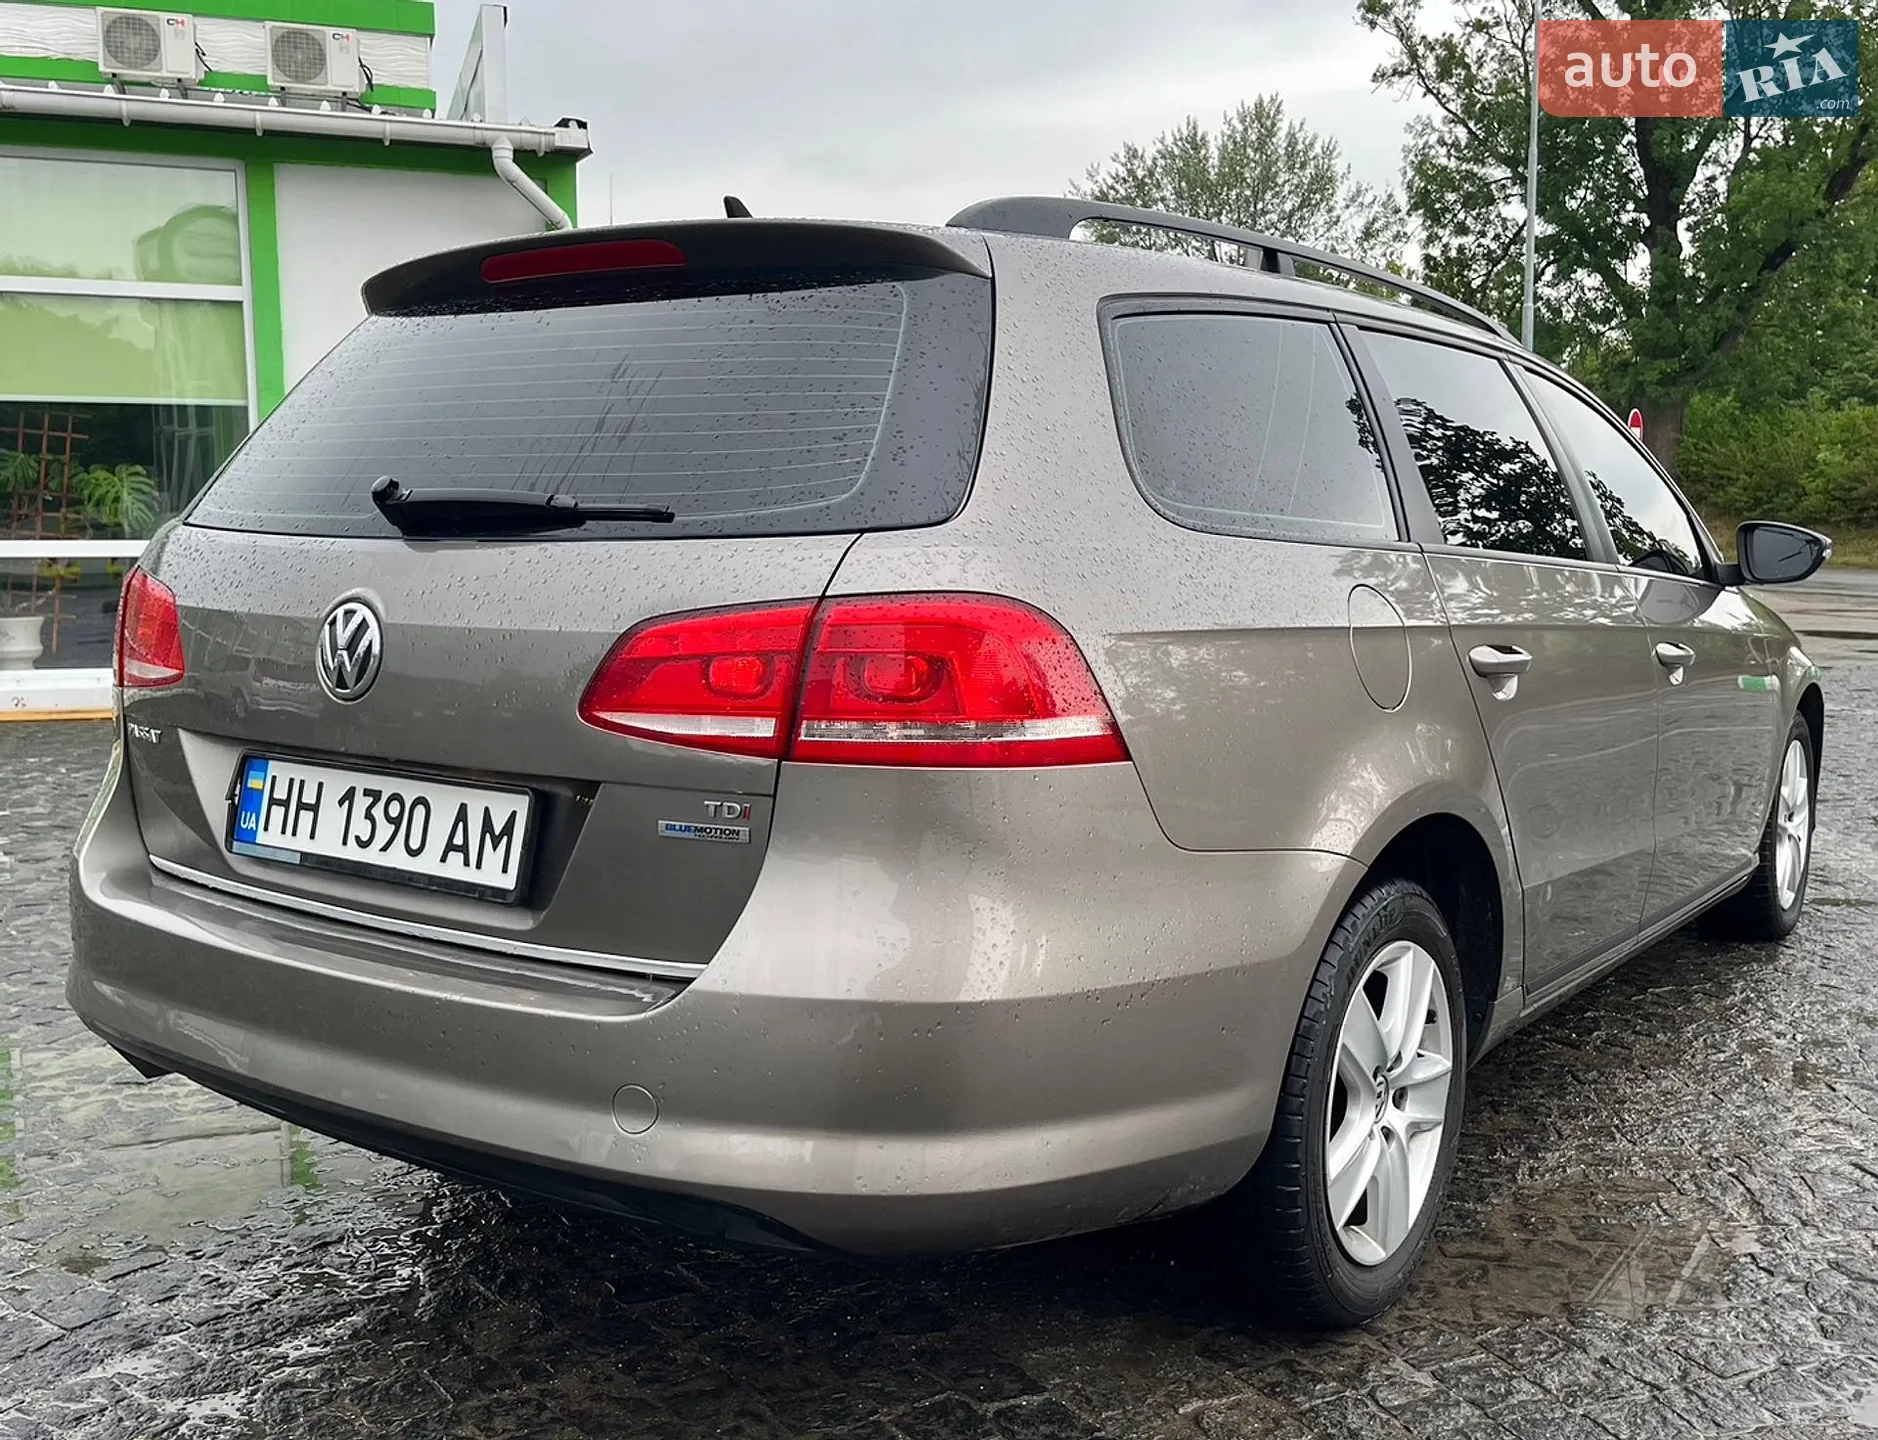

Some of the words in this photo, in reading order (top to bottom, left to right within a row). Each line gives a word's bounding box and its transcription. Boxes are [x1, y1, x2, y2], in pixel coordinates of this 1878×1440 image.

[167, 18, 185, 27] CH
[332, 32, 350, 42] CH
[241, 810, 257, 831] UA
[263, 775, 324, 840] HH
[337, 786, 431, 857] 1390
[440, 802, 517, 873] AM
[665, 823, 740, 837] BLUEMOTION
